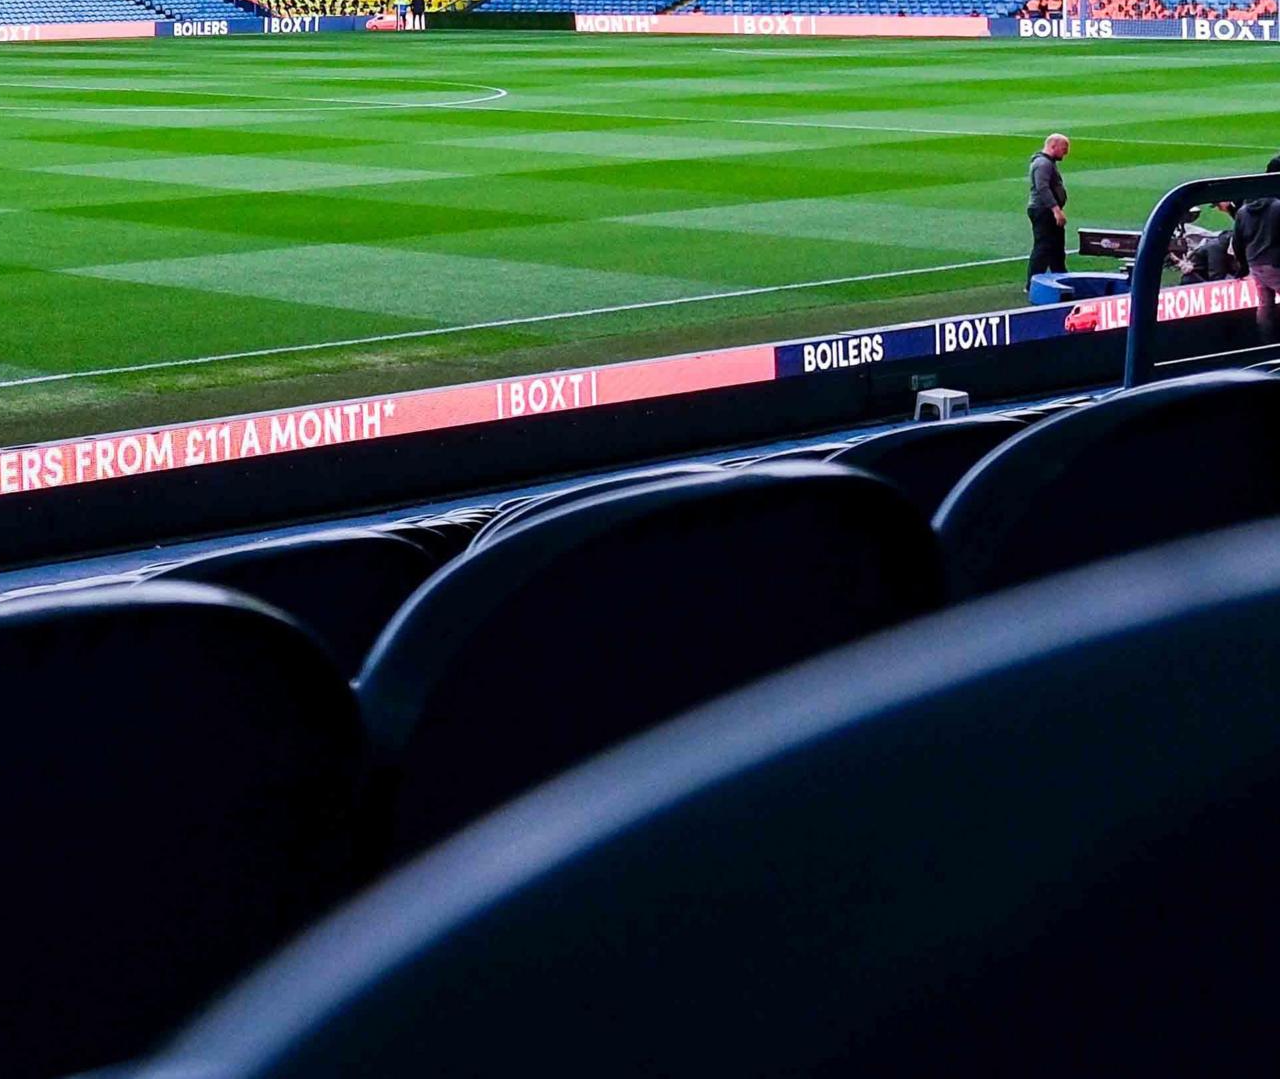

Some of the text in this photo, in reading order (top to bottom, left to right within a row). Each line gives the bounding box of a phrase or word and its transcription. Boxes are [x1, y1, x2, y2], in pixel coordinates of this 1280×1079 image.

[174, 21, 228, 36] BOILERS
[1020, 20, 1113, 38] BOILERS
[1211, 282, 1234, 314] £11
[1240, 280, 1252, 307] A
[804, 334, 883, 372] BOILERS
[76, 433, 174, 480] FROM
[185, 423, 232, 466] £11
[241, 421, 261, 457] A
